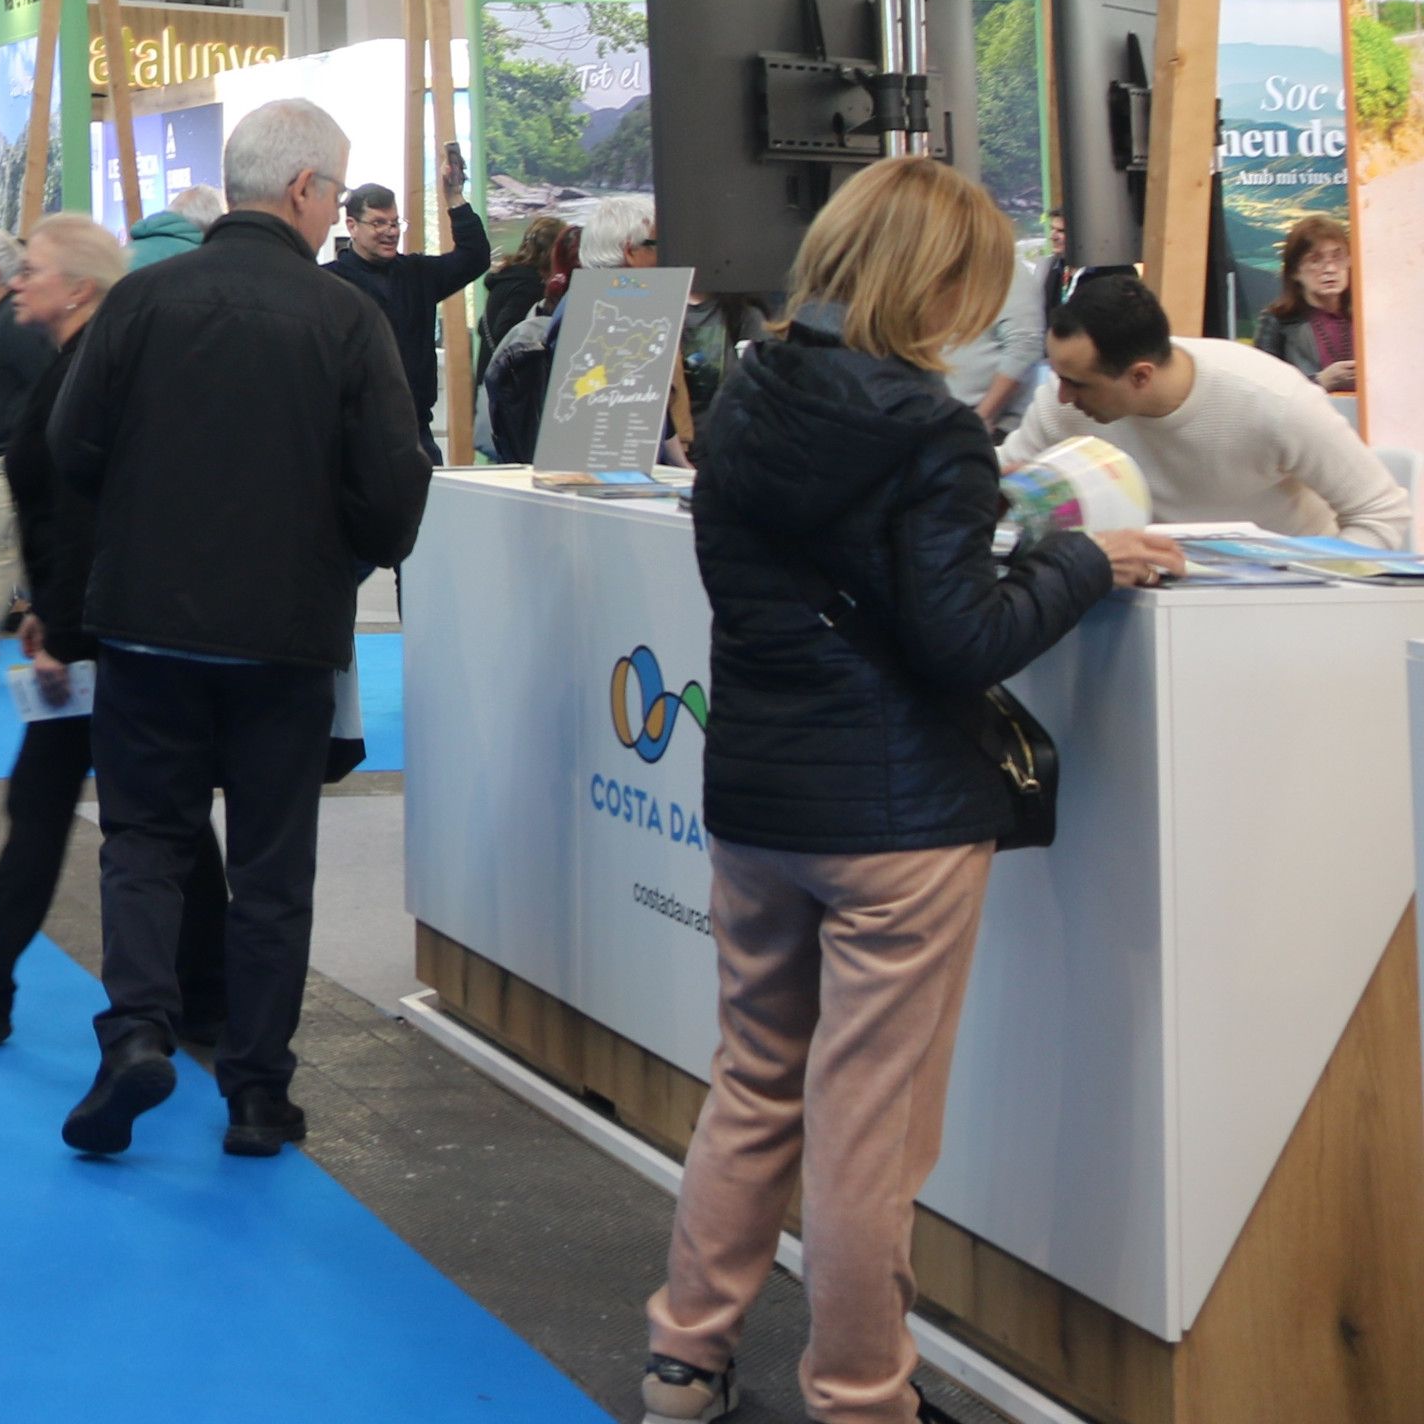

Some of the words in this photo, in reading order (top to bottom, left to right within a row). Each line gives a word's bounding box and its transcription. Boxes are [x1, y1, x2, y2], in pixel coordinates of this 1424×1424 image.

[88, 24, 286, 88] atalunya
[575, 61, 614, 93] Tot
[620, 60, 641, 89] el
[1260, 75, 1329, 112] Soc
[1220, 127, 1290, 158] neu
[1235, 167, 1274, 185] Amb
[1275, 168, 1298, 185] mi
[1298, 167, 1333, 185] vius
[591, 773, 663, 835] COSTA
[670, 801, 708, 852] DA
